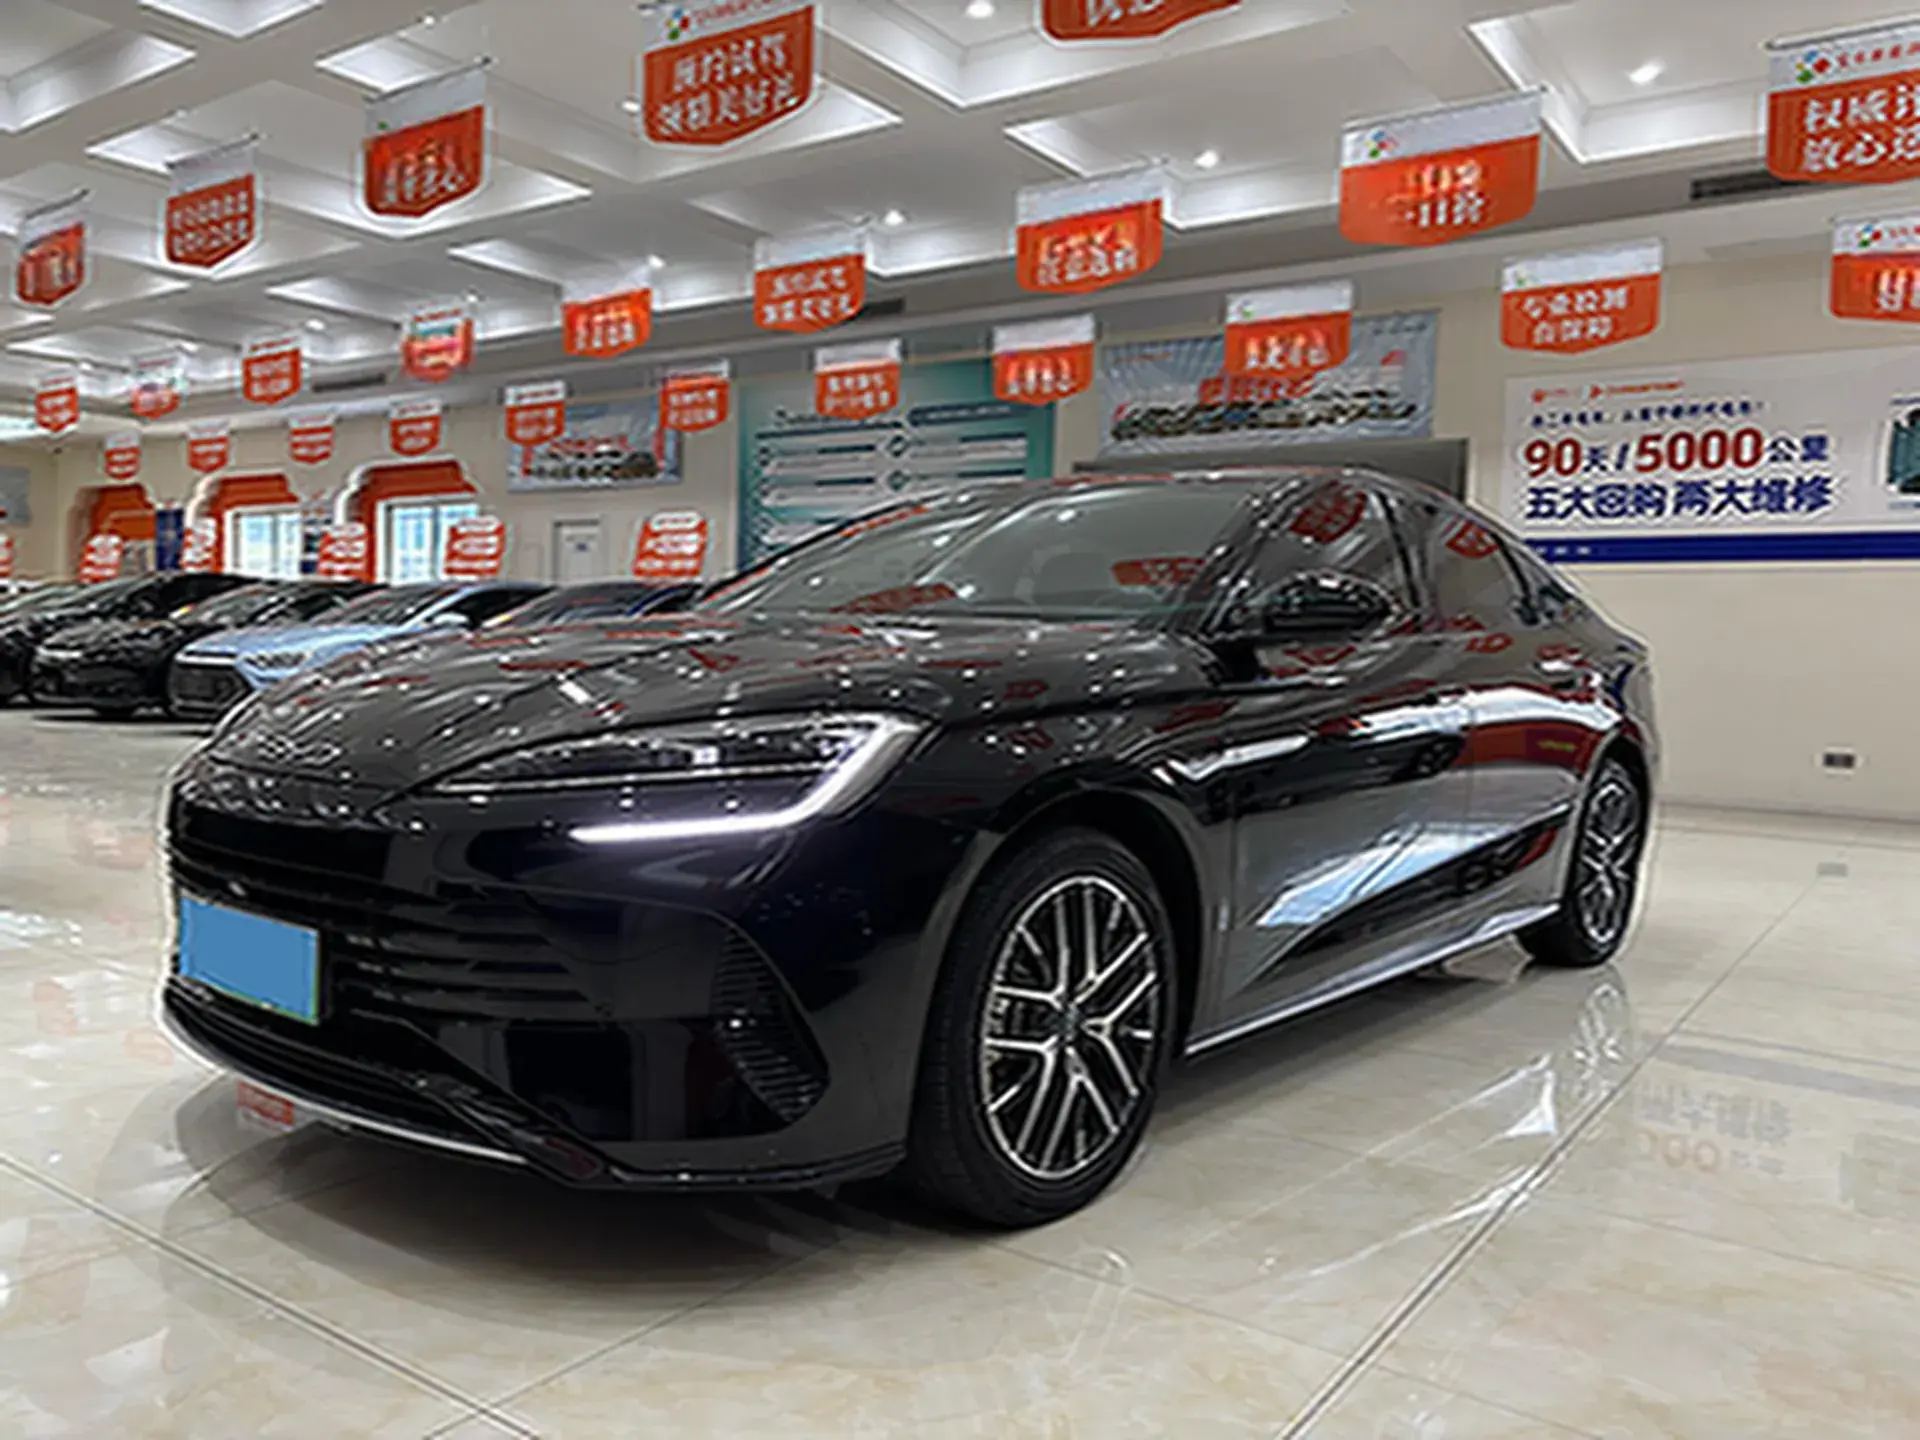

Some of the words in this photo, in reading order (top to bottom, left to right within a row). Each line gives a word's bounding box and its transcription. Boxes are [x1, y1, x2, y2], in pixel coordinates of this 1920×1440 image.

[1525, 482, 1668, 521] 五大回购
[1672, 475, 1834, 519] 两大维修
